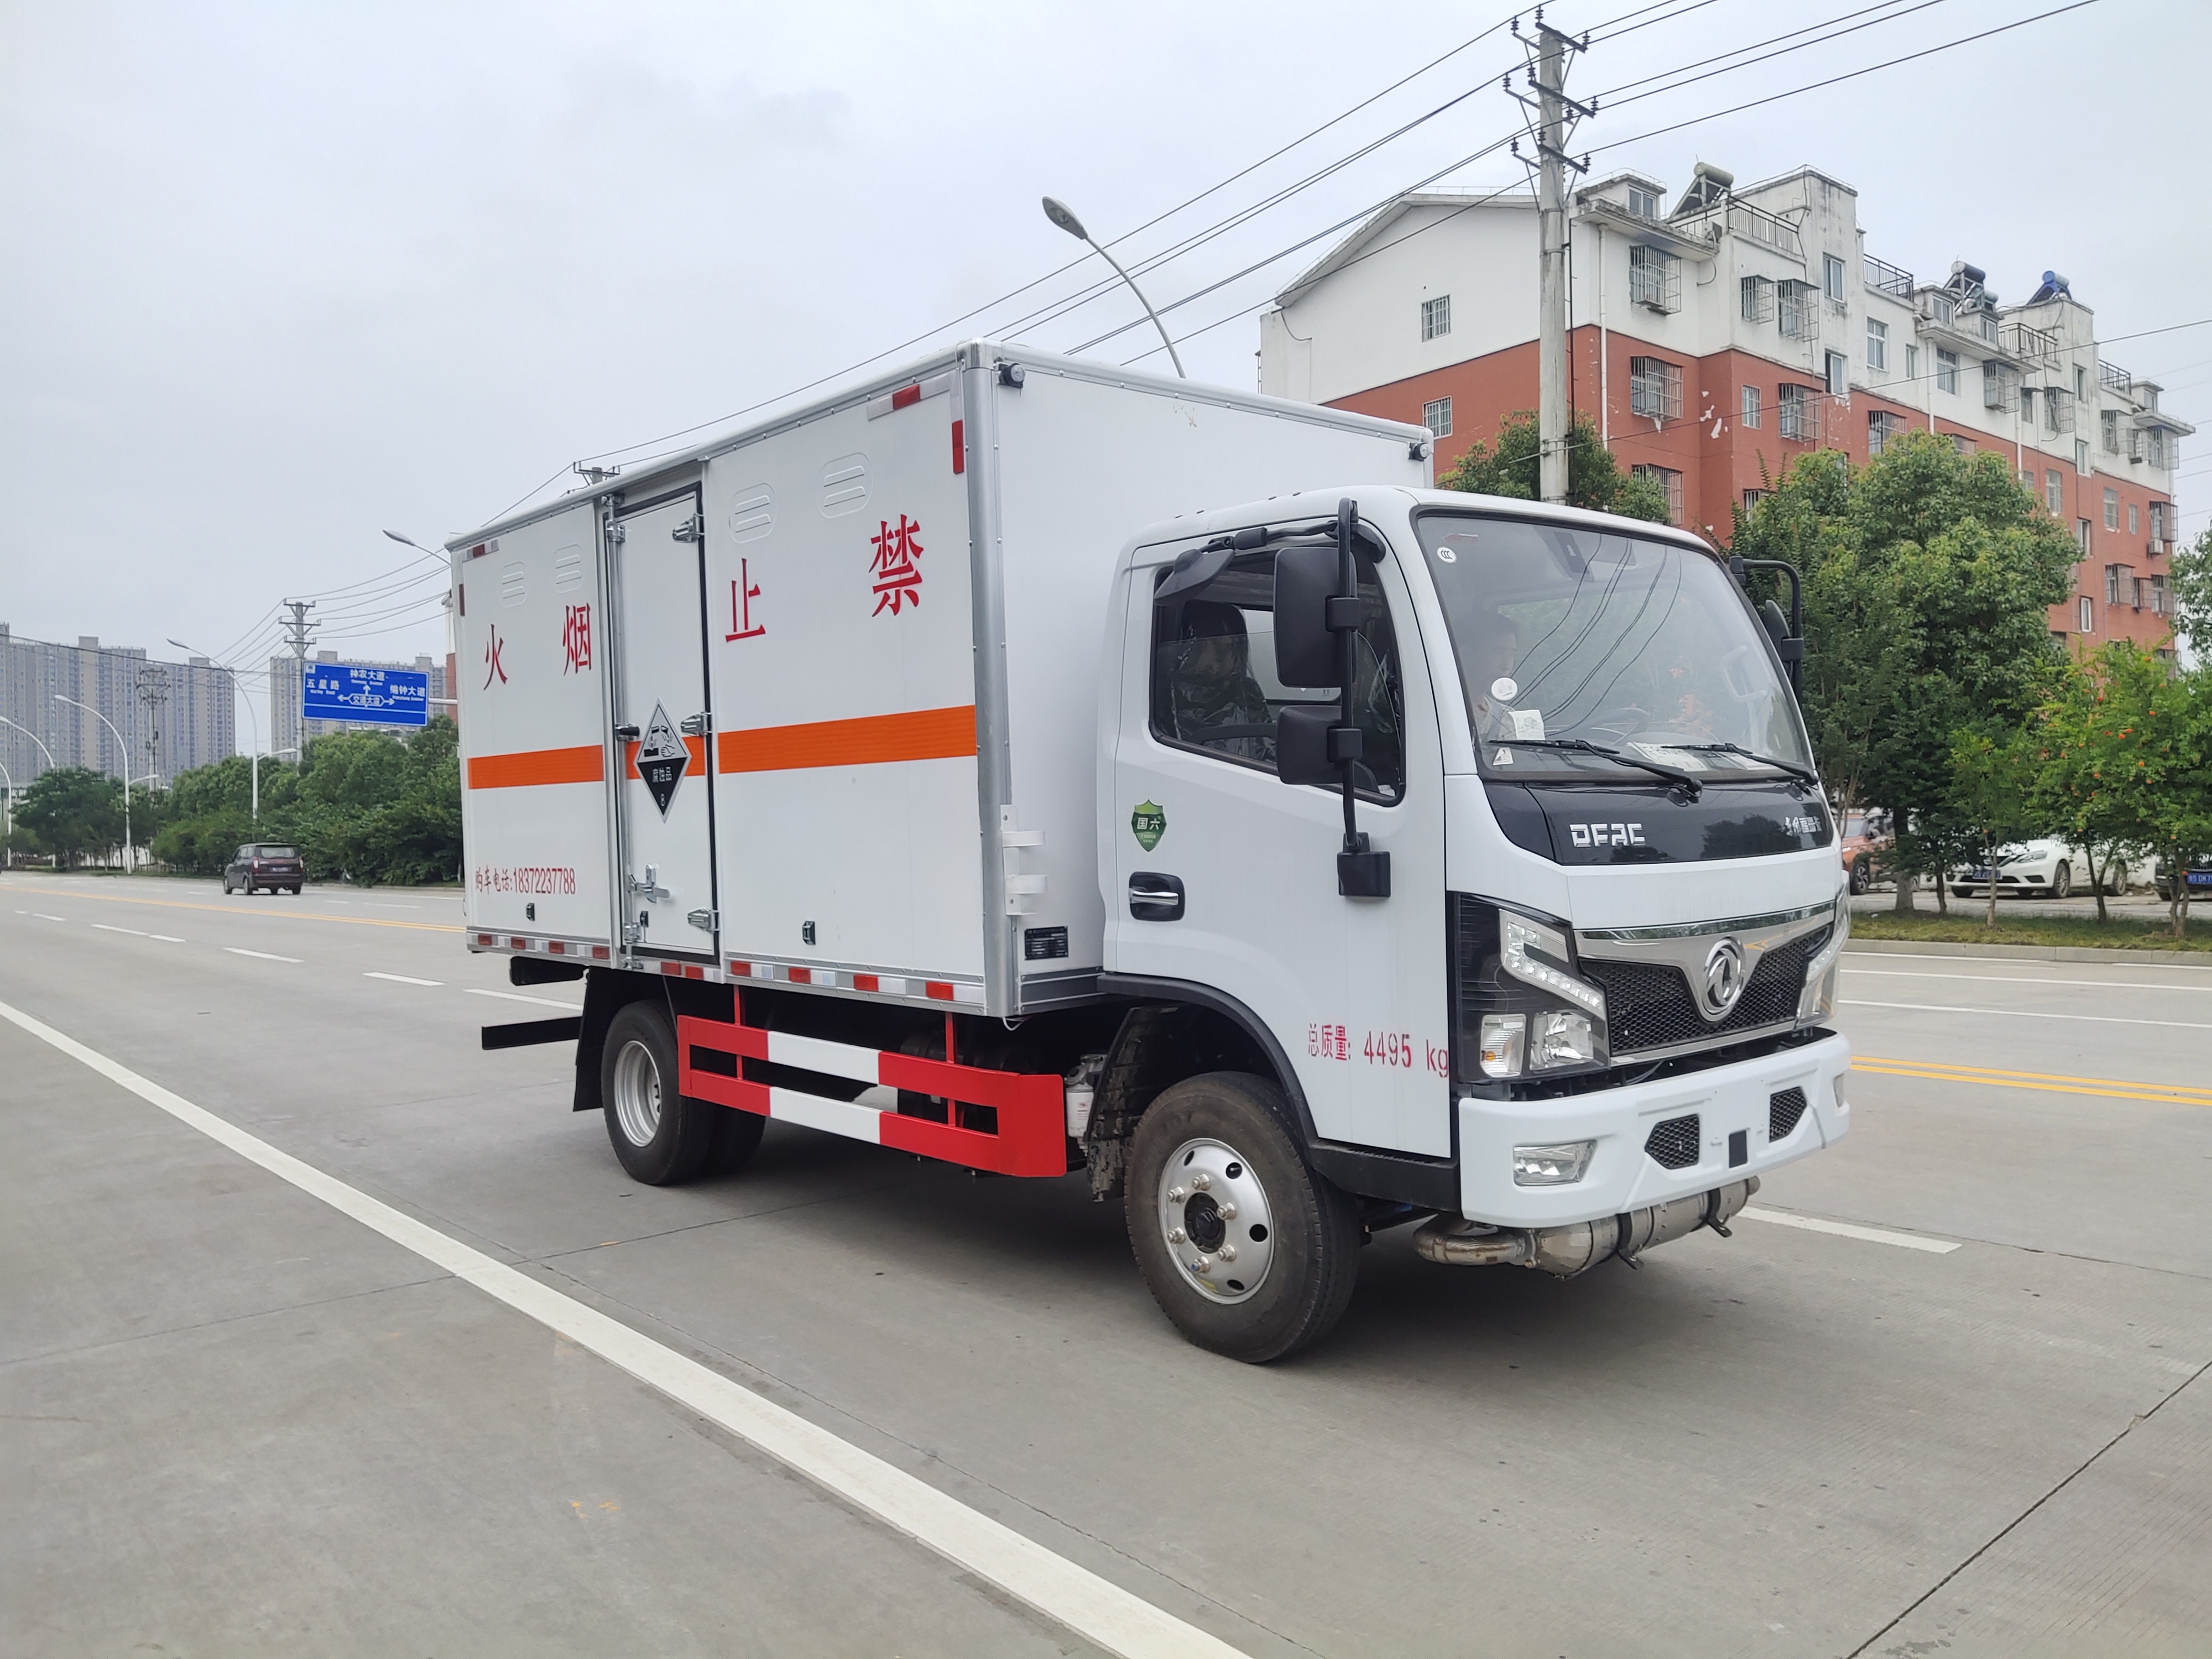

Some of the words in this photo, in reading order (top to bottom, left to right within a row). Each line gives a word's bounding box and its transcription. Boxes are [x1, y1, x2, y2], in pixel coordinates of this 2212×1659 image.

[868, 514, 924, 617] 禁
[725, 558, 766, 643] 止
[483, 624, 508, 691] 火
[562, 602, 592, 676] 烟
[306, 679, 340, 690] 五星路
[661, 794, 665, 806] 8
[1138, 818, 1160, 830] 国六
[1569, 823, 1646, 847] DFAC
[1364, 1030, 1412, 1068] 4495
[1426, 1039, 1448, 1078] kg
